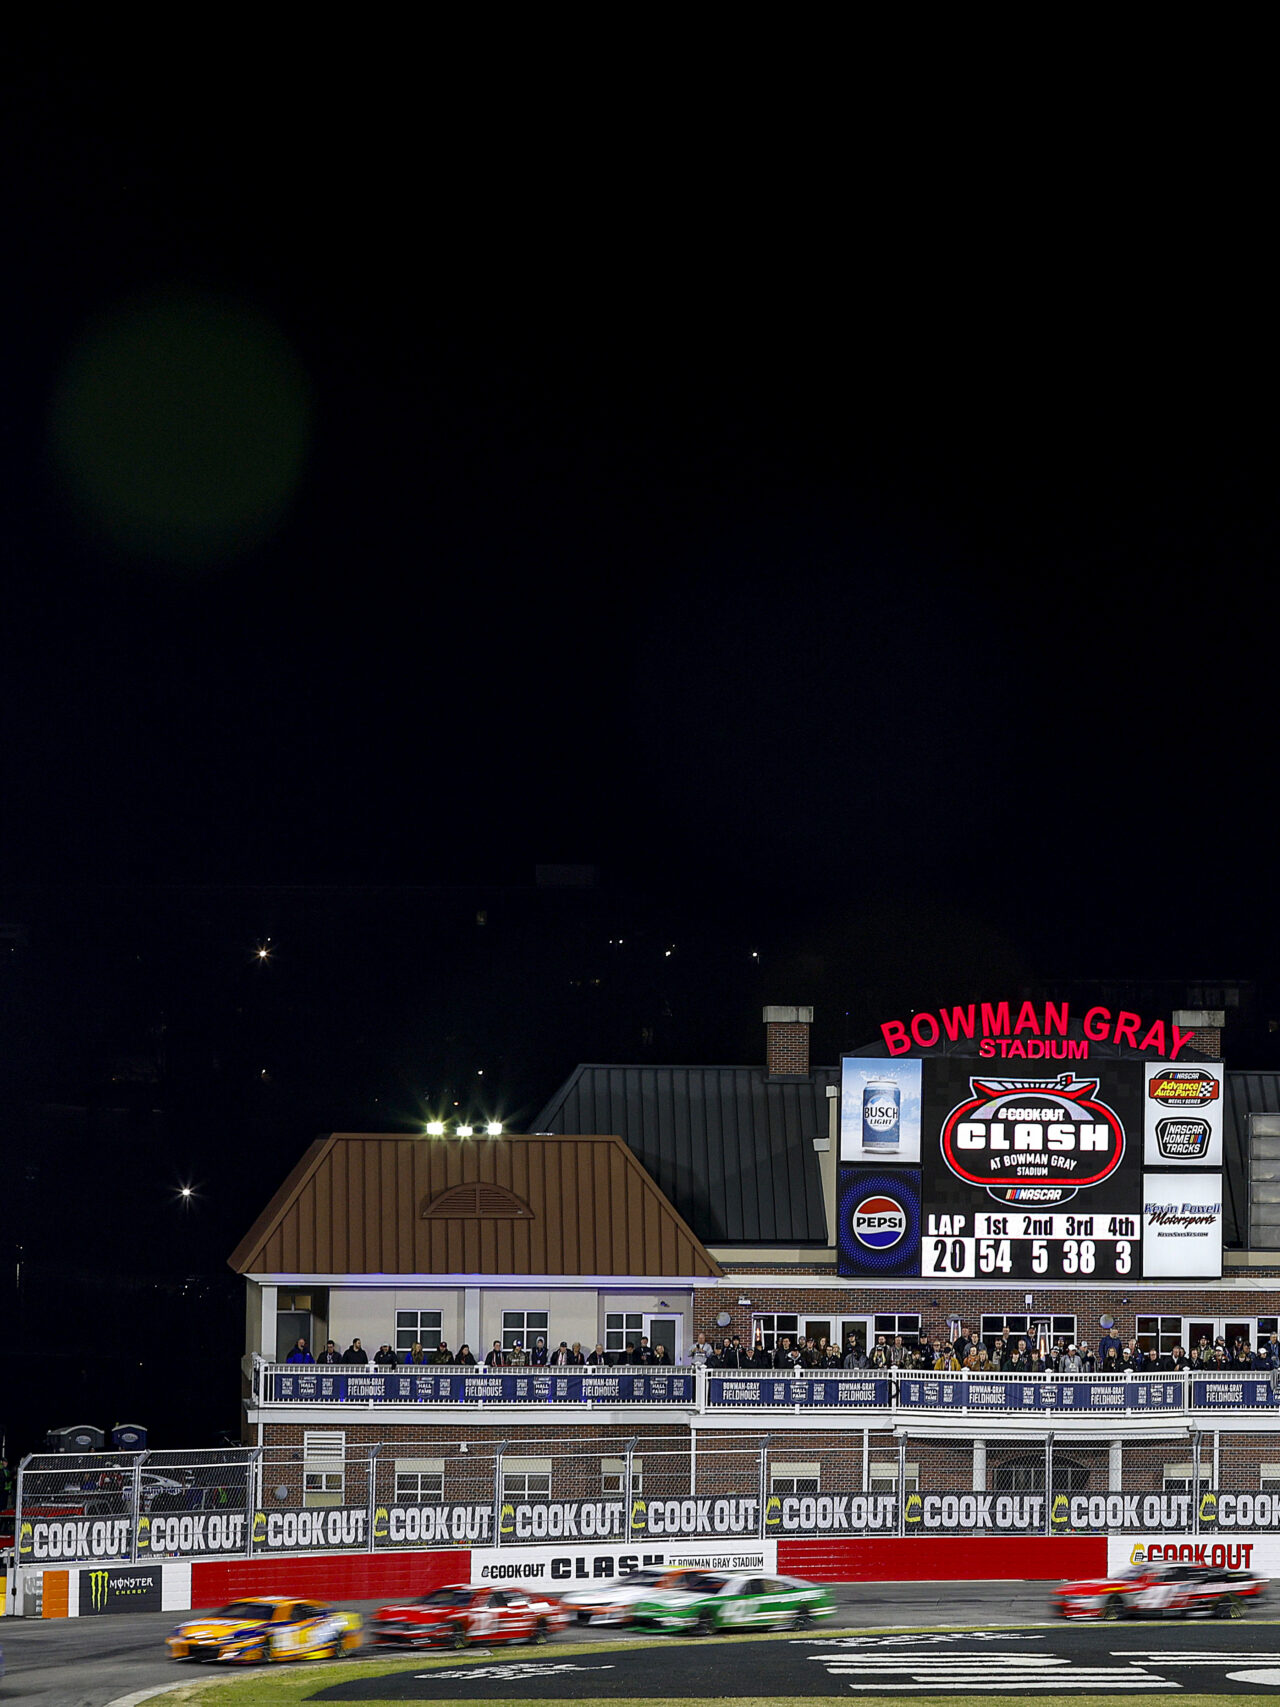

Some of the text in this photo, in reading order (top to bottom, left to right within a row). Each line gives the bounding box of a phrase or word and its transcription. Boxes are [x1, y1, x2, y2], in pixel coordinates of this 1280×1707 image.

[880, 1000, 1195, 1060] BOWMAN GRAY
[979, 1038, 1089, 1060] STADIUM
[1158, 1081, 1199, 1090] Advance
[1175, 1089, 1197, 1097] Parts
[864, 1106, 898, 1119] BUSCH
[1007, 1108, 1065, 1121] COOK OUT
[1168, 1125, 1204, 1134] NASCAR
[956, 1122, 1109, 1151] CLASH
[1163, 1134, 1190, 1143] HOME
[1166, 1144, 1201, 1153] TRACKS
[990, 1153, 1077, 1171] AT BOWMAN GRAY
[1016, 1167, 1048, 1176] STADIUM
[1019, 1189, 1063, 1200] NASCAR
[1144, 1203, 1221, 1214] Kevin Powell
[856, 1217, 903, 1228] PEPSI
[928, 1214, 1135, 1236] LAP 1st 2nd 3rd 4th
[1148, 1212, 1217, 1229] Motorsports
[933, 1239, 1132, 1274] 20 54 5 38 3
[348, 1378, 385, 1386] BOWMAN-GRAY
[722, 1382, 760, 1390] BOWMAN-GRAY
[838, 1382, 875, 1390] BOWMAN-GRAY
[348, 1386, 385, 1396] FIELDHOUSE
[465, 1386, 502, 1396] FIELDHOUSE
[582, 1386, 619, 1396] FIELDHOUSE
[969, 1386, 1006, 1394] BOWMAN-GRAY
[1090, 1386, 1125, 1395] BOWMAN-GRAY
[1206, 1384, 1243, 1392] BOWMAN-GRAY
[722, 1390, 760, 1400] FIELDHOUSE
[838, 1390, 875, 1400] FIELDHOUSE
[969, 1394, 1006, 1404] FIELDHOUSE
[1090, 1395, 1125, 1405] FIELDHOUSE
[1206, 1391, 1243, 1402] FIELDHOUSE
[648, 1499, 758, 1532] COOK OUT
[782, 1496, 897, 1529] COOK OUT
[923, 1495, 1044, 1527] COOK OUT
[1070, 1495, 1192, 1527] COOK OUT
[390, 1506, 492, 1541] COOK OUT
[515, 1502, 624, 1537] COOK OUT
[151, 1514, 245, 1551] COOK OUT
[267, 1510, 367, 1546] COOK OUT
[34, 1519, 131, 1557] COOK OUT
[1147, 1543, 1254, 1569] COOK OUT
[550, 1554, 664, 1580] CLASH
[712, 1557, 731, 1568] GRAY
[732, 1556, 764, 1568] STADIUM
[490, 1563, 546, 1579] COOK OUT
[109, 1577, 154, 1590] MONSTER
[115, 1588, 147, 1596] ENERGY
